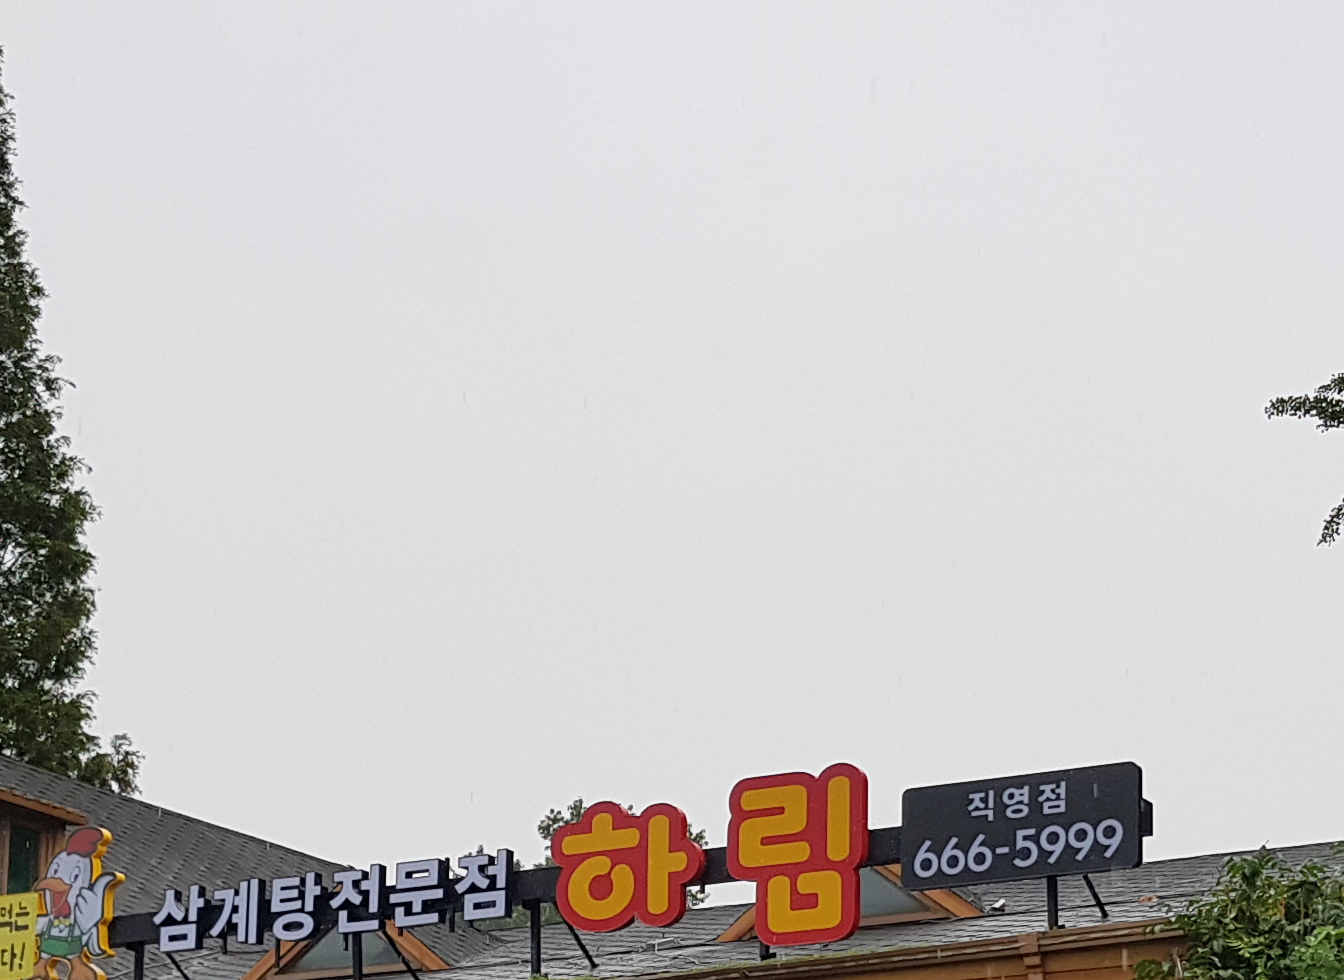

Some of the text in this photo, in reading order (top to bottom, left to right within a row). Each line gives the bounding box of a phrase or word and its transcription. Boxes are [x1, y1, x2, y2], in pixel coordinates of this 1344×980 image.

[967, 781, 1067, 822] 직영점
[556, 770, 859, 940] 하림
[913, 818, 1124, 878] 666-5999
[152, 848, 510, 951] 삼계탕전문점
